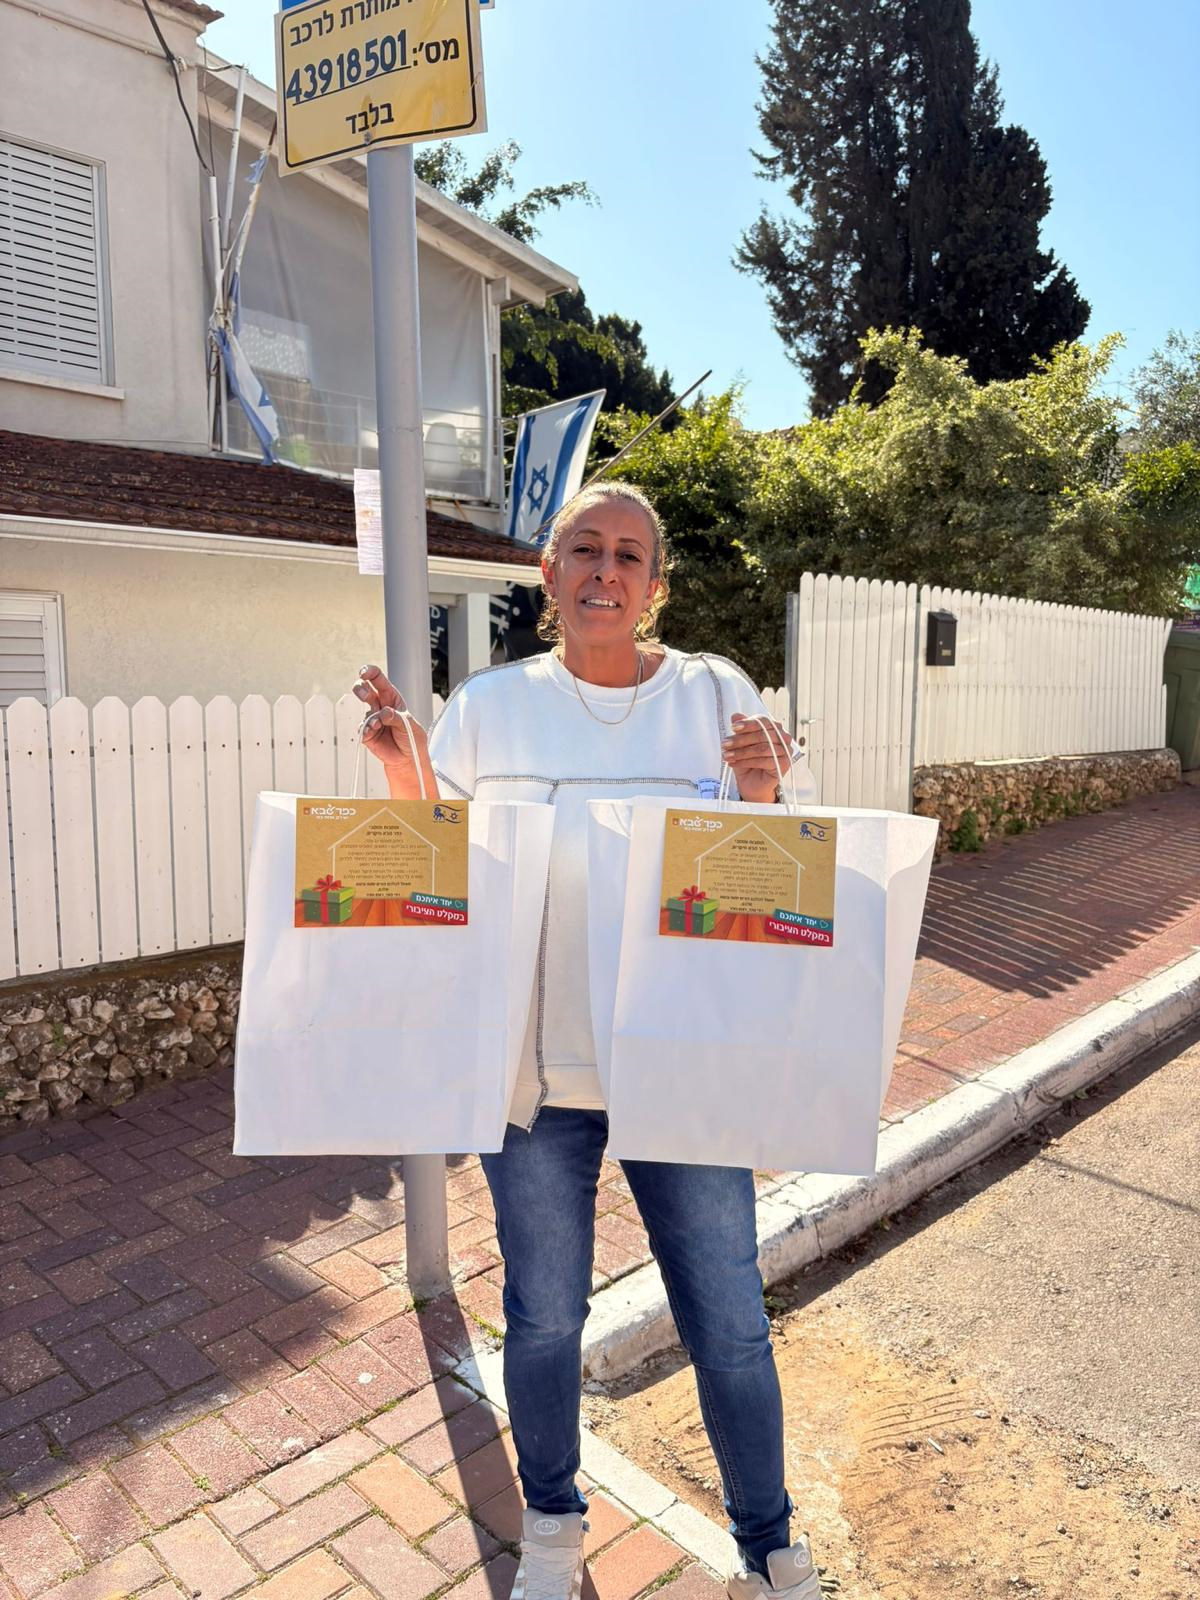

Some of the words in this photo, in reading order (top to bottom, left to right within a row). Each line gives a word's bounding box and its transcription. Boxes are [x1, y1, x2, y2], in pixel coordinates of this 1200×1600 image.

[290, 10, 334, 46] לרכב
[286, 29, 407, 103] 43918501
[345, 103, 395, 134] בלבד
[335, 807, 356, 816] כפר
[440, 898, 453, 907] יחד
[406, 904, 435, 916] הציבורי
[437, 909, 465, 921] במקלט
[779, 912, 803, 923] איתכם
[804, 917, 817, 926] יחד
[769, 921, 799, 935] הציבורי
[800, 928, 830, 942] במקלט
